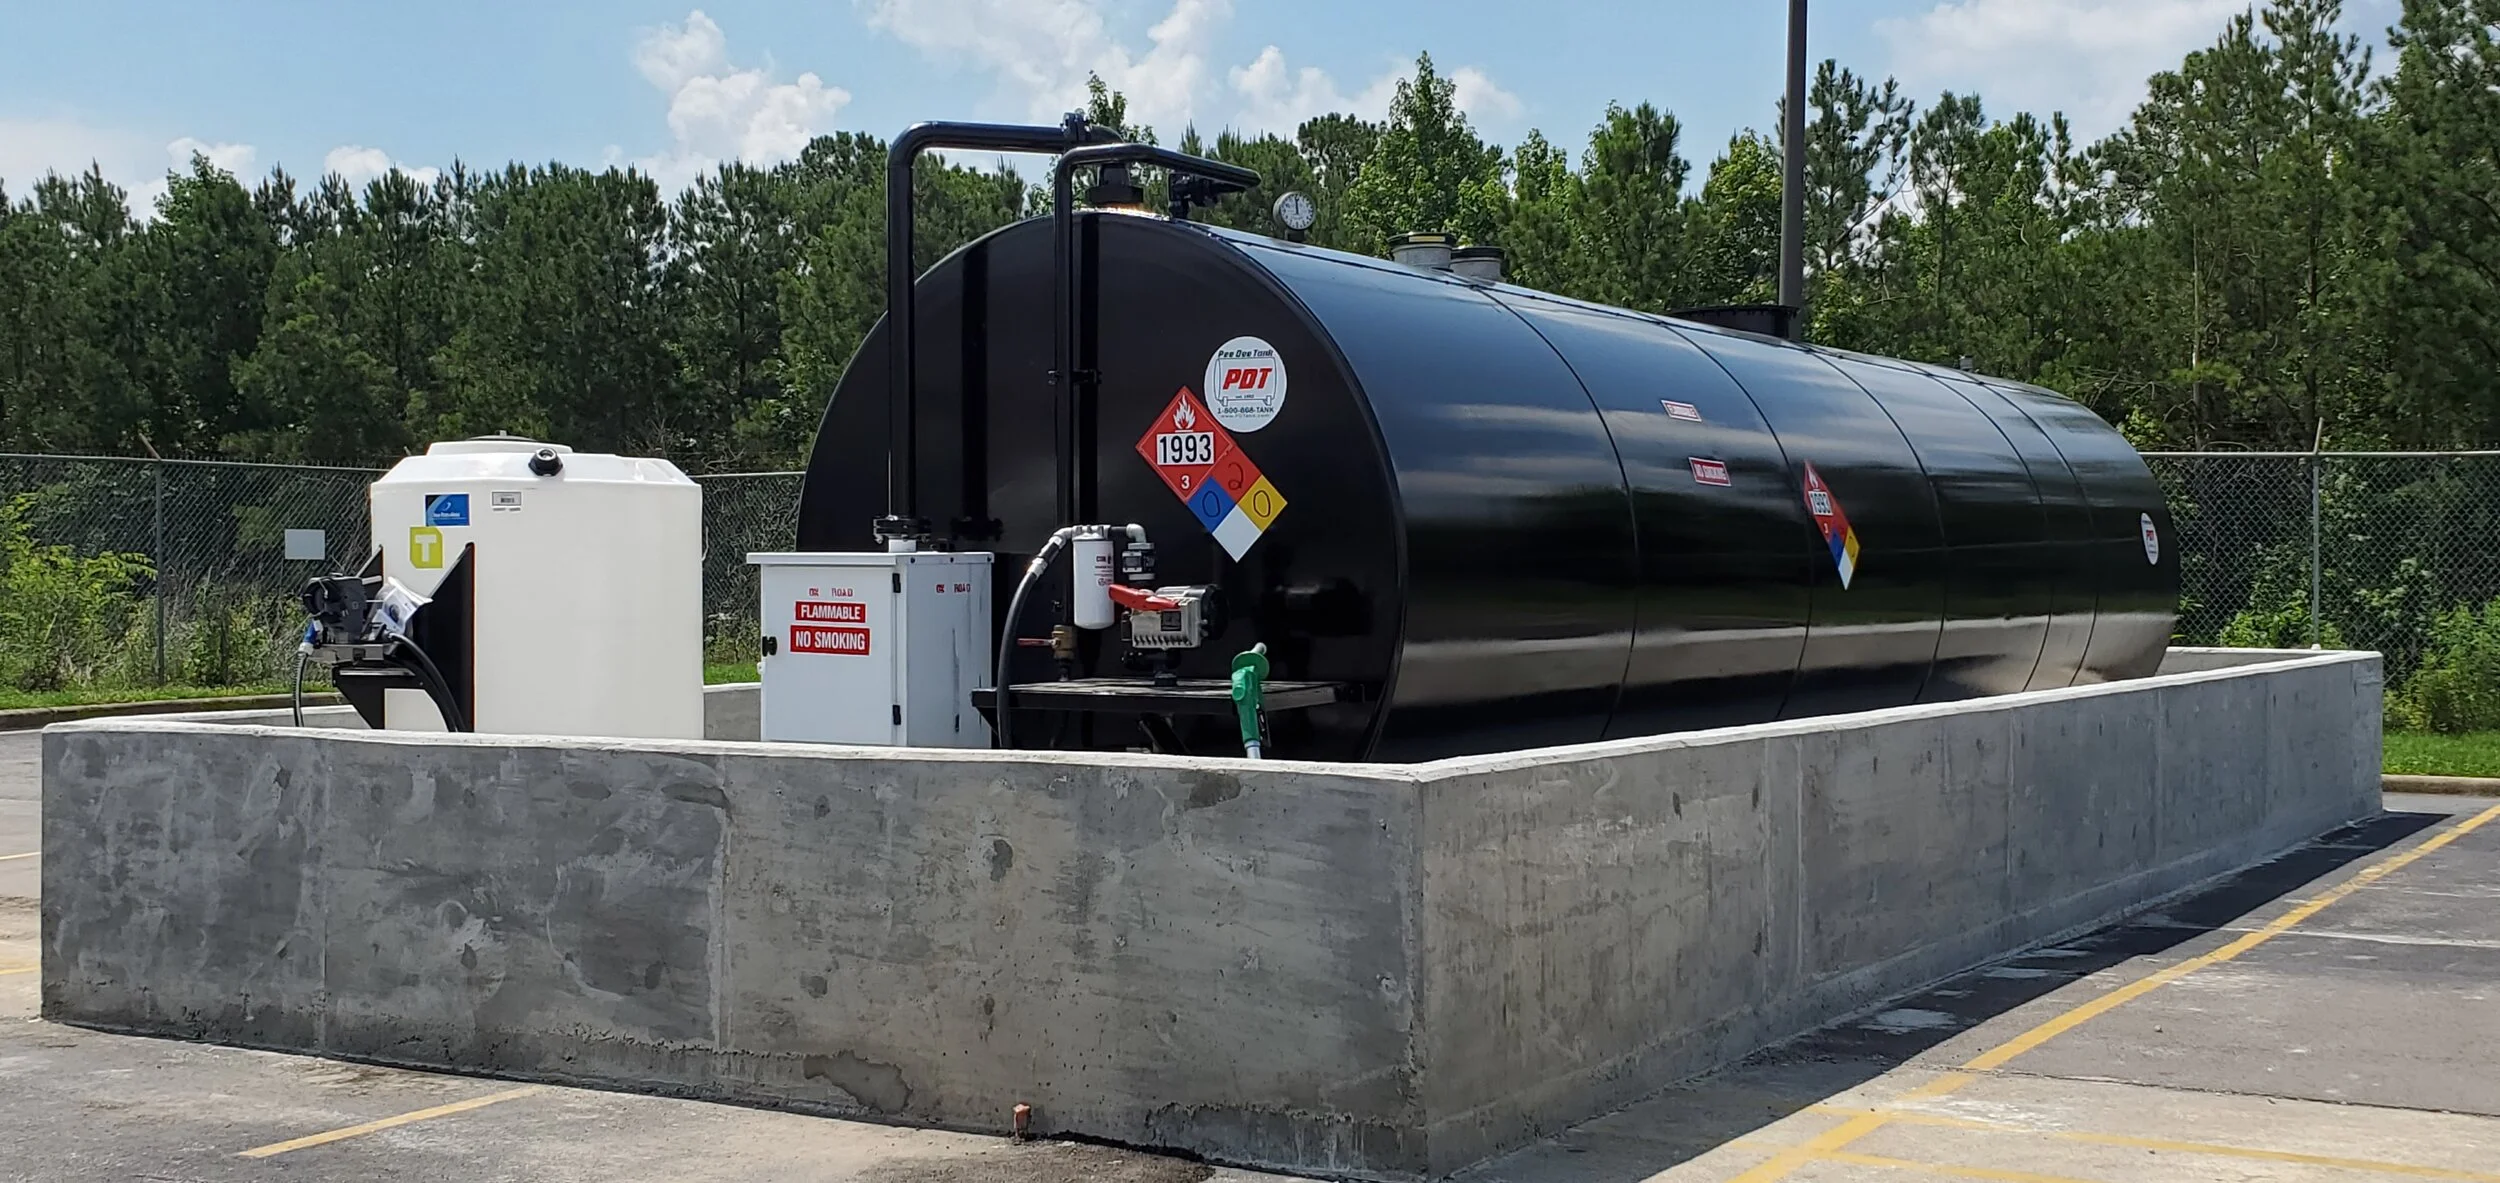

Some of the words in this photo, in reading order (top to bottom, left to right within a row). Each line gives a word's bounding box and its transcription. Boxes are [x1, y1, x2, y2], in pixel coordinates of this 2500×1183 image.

[1218, 350, 1234, 358] Pee
[1235, 349, 1252, 358] Dee
[1253, 348, 1274, 357] Tank
[1160, 434, 1212, 463] 1993
[1181, 475, 1190, 489] 3
[1227, 462, 1244, 490] 2
[1253, 490, 1271, 518] 0
[415, 534, 437, 562] T
[801, 604, 861, 620] FLAMMABLE
[795, 630, 811, 648] NO
[814, 631, 866, 650] SMOKING
